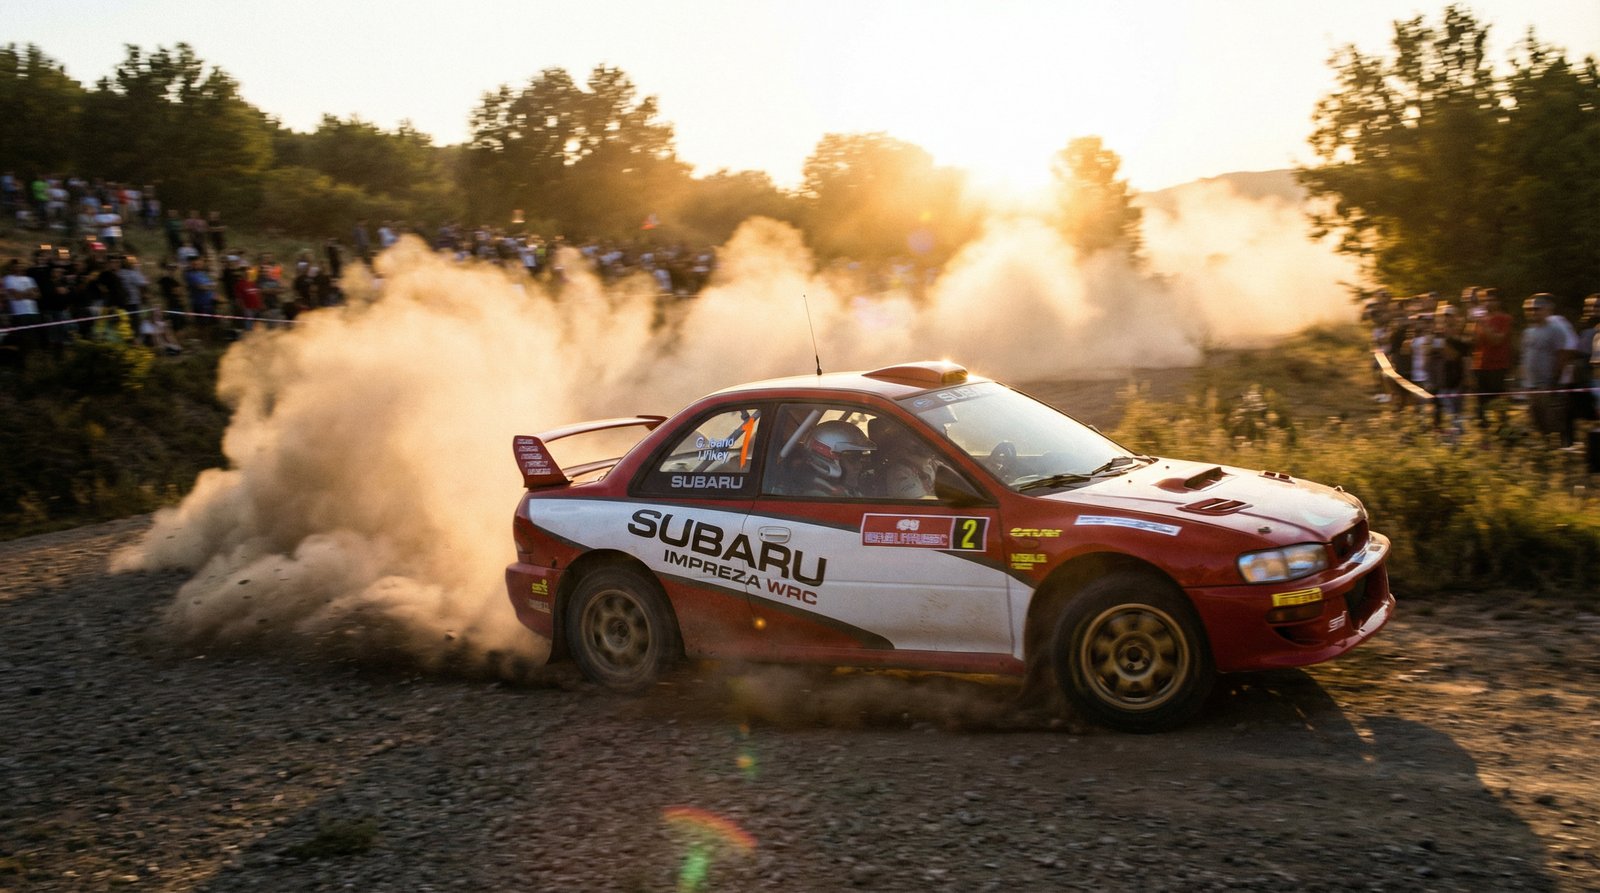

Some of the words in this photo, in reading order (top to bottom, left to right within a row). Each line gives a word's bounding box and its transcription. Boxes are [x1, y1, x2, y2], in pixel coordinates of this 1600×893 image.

[671, 475, 744, 489] SUBARU
[627, 508, 828, 587] SUBARU
[961, 519, 978, 549] 2
[663, 549, 761, 590] IMPREZA
[766, 577, 818, 606] WRC
